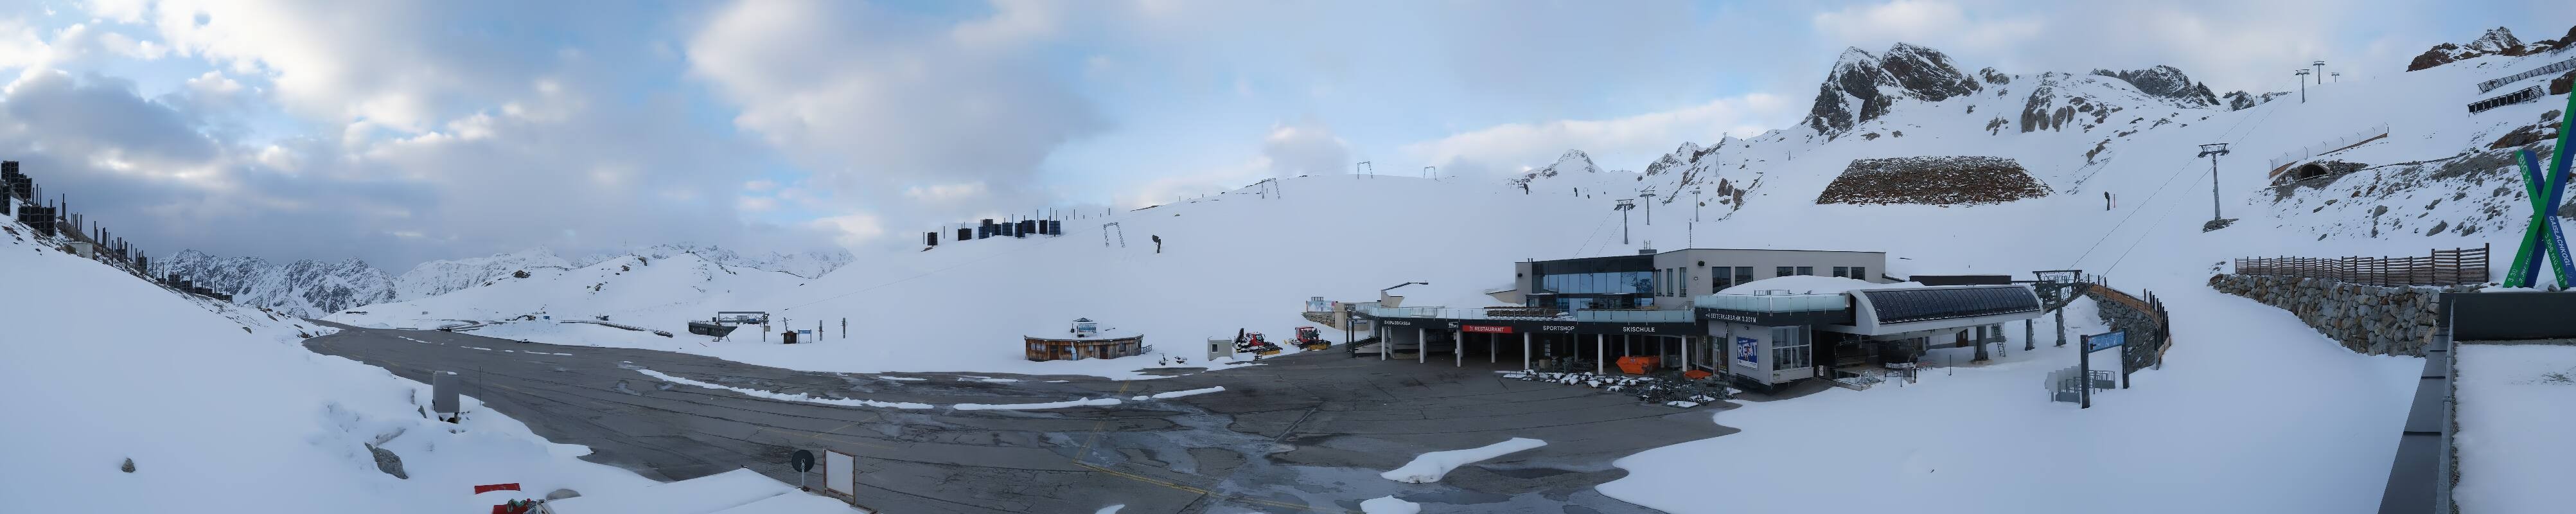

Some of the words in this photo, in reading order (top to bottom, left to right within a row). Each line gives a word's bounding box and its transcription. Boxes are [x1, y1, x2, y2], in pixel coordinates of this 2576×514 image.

[2518, 154, 2528, 175] BIG
[2525, 175, 2531, 184] 3
[2545, 233, 2554, 253] 3.056
[2549, 216, 2571, 267] GAISLACHKOGL
[1737, 342, 1758, 357] RENT
